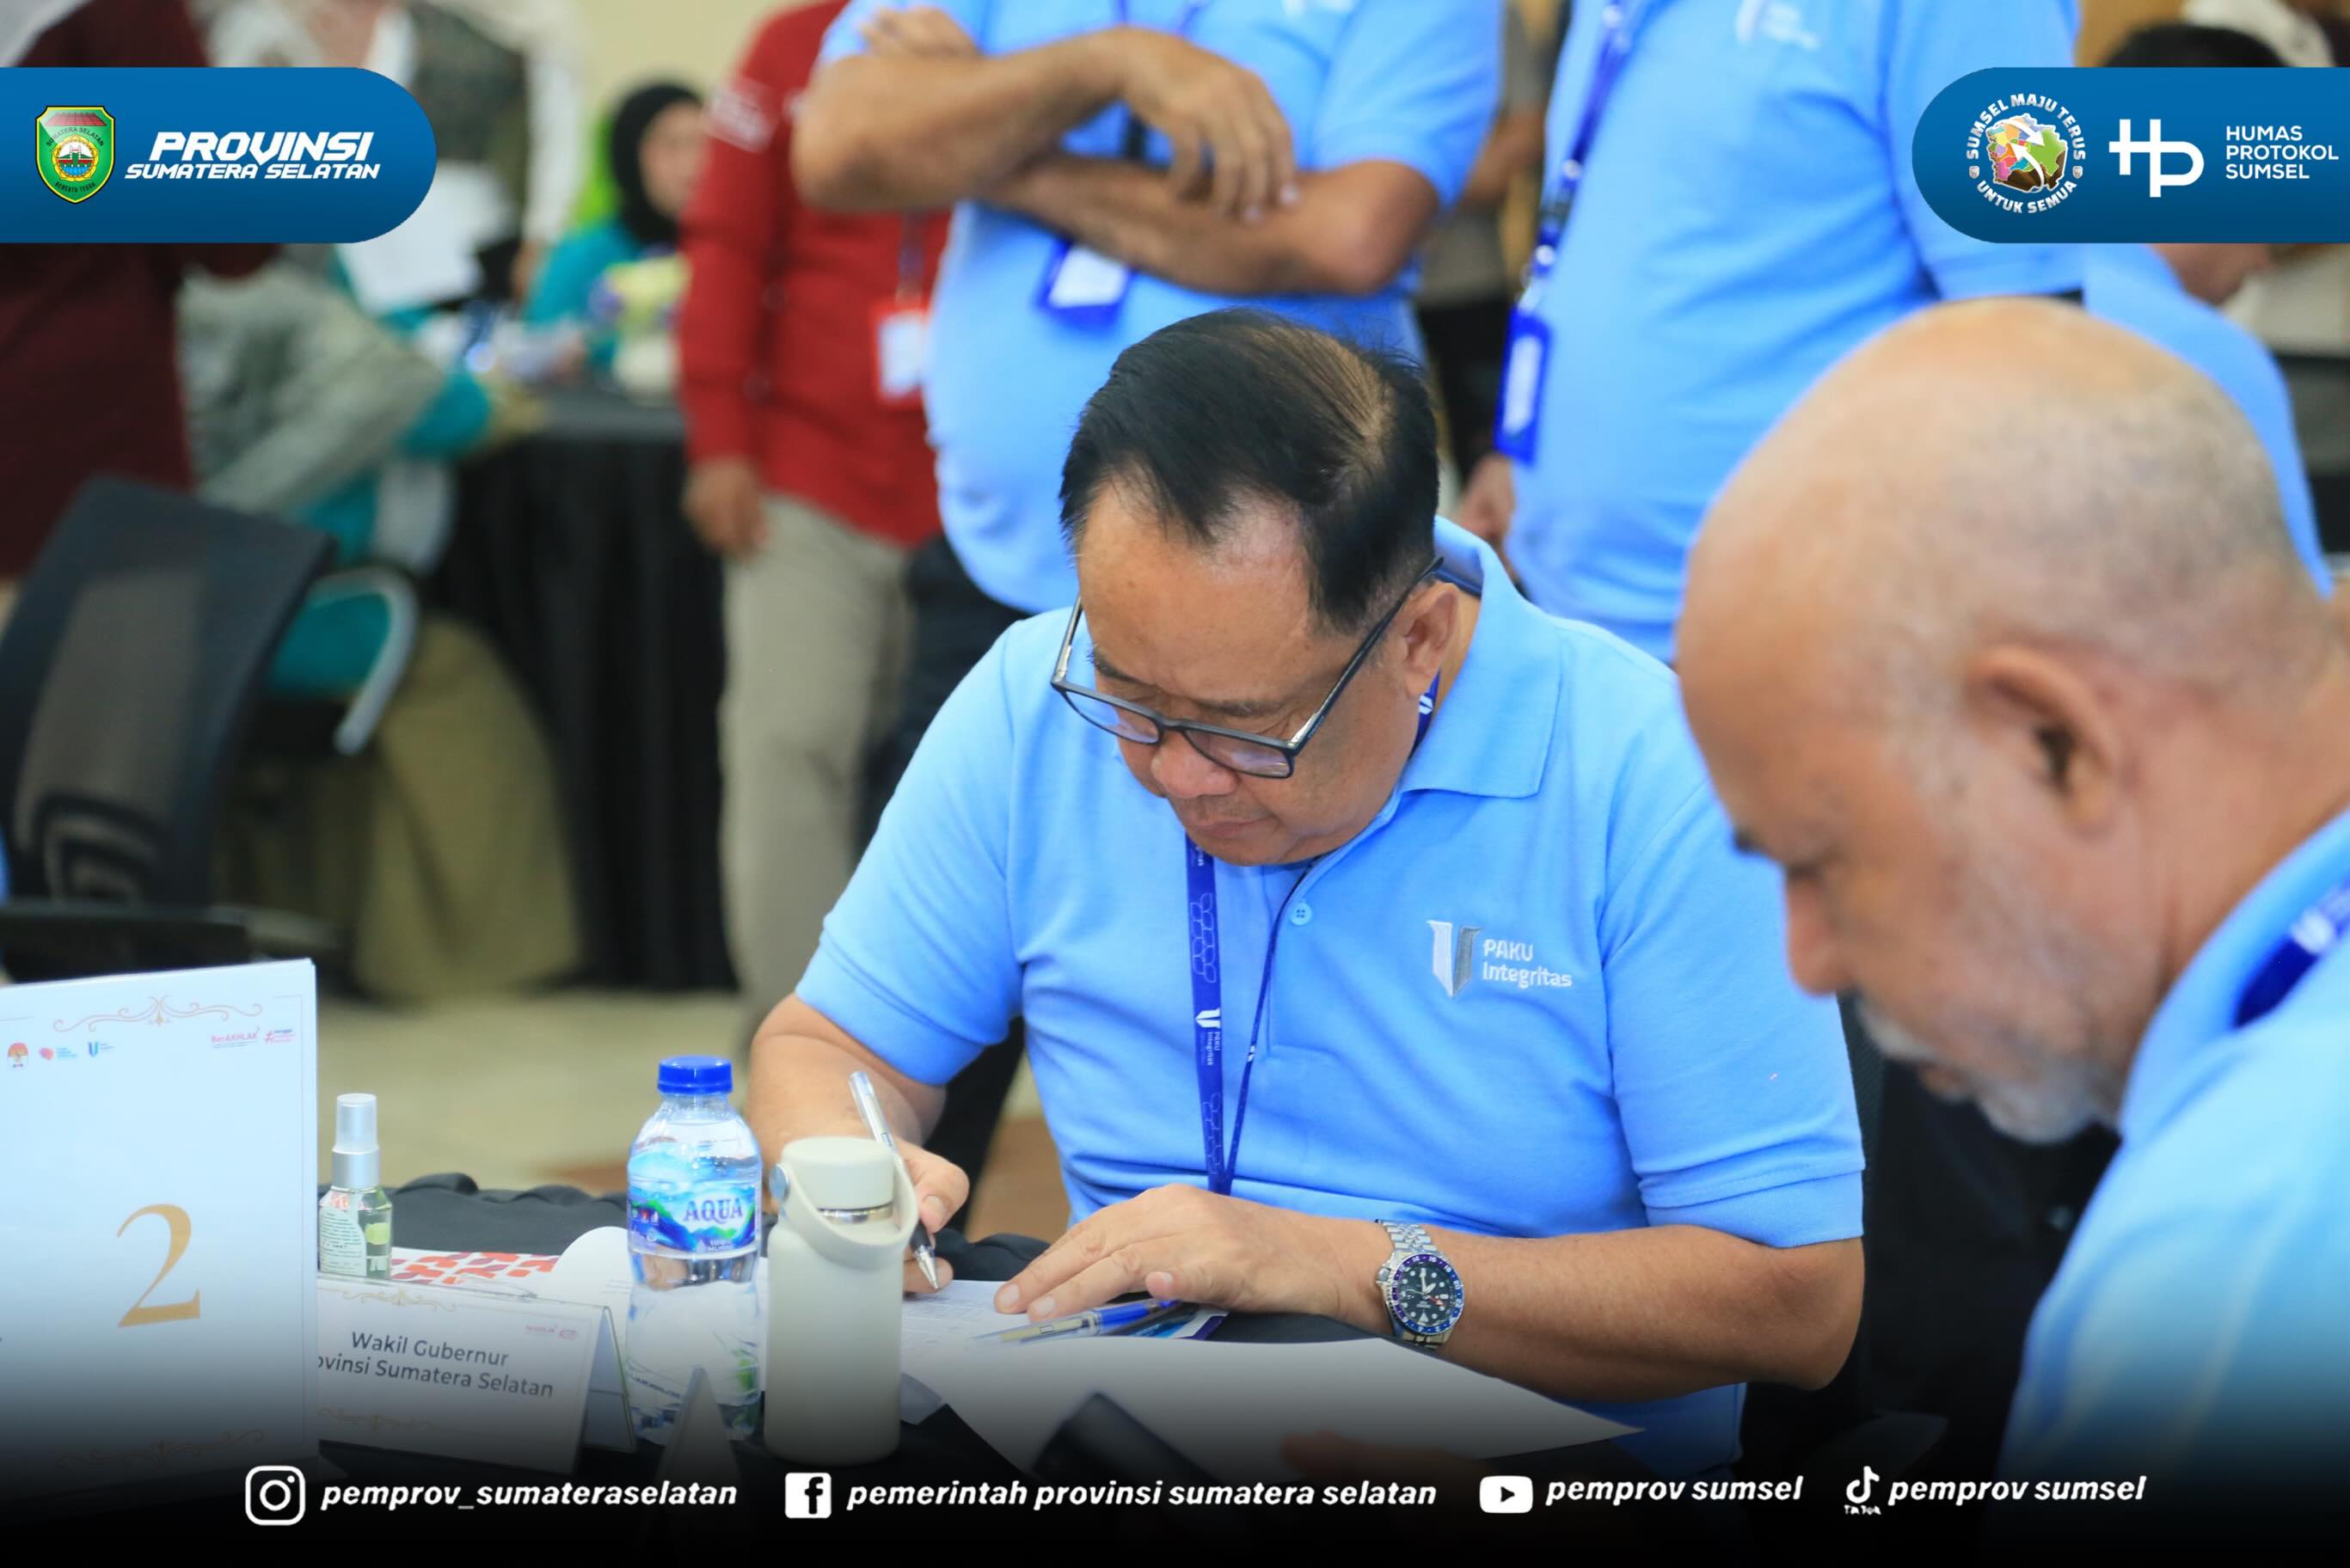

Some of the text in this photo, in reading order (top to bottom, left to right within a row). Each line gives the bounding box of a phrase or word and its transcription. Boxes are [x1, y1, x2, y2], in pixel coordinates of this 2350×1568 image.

[1483, 938, 1534, 962] PAKU
[1482, 961, 1573, 989] Integritas
[683, 1197, 744, 1224] AQUA
[116, 1203, 201, 1328] 2
[352, 1331, 509, 1367] Wakil Gubernur
[375, 1359, 471, 1387] Sumatera
[477, 1371, 553, 1398] Selatan
